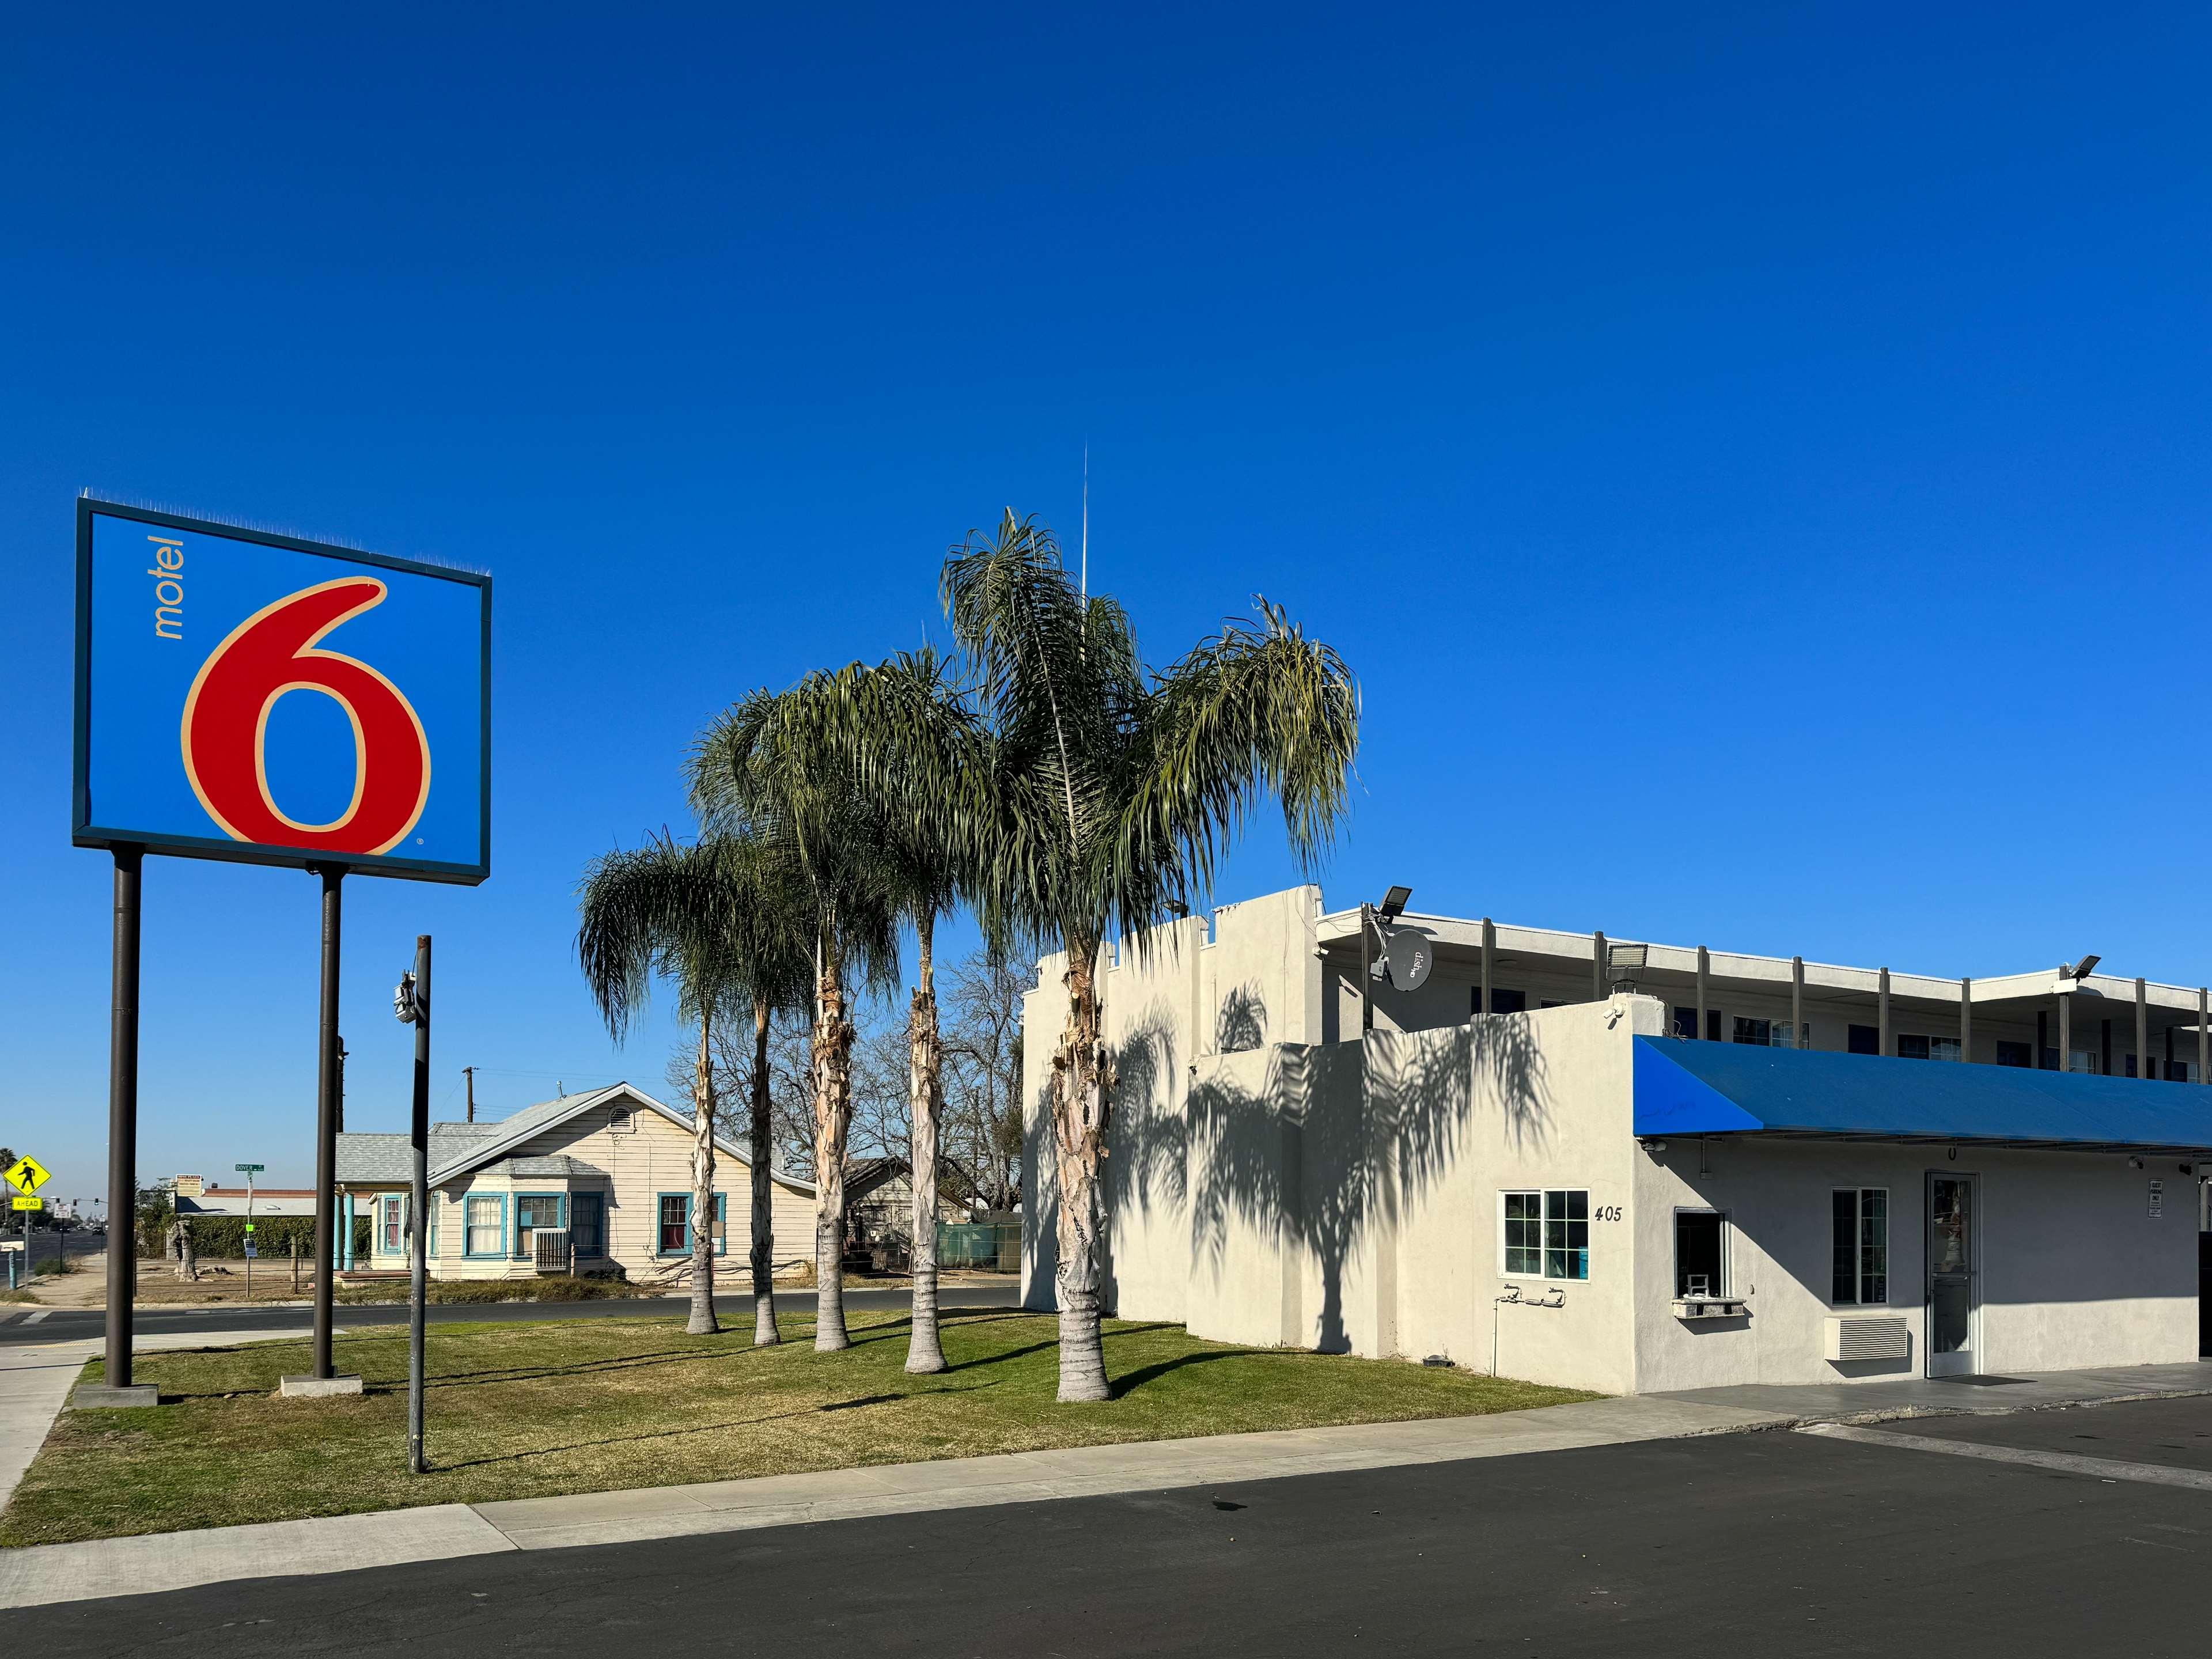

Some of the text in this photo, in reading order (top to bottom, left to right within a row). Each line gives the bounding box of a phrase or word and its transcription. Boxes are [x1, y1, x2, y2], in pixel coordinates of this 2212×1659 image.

[147, 535, 184, 640] motel
[181, 575, 431, 855] 6
[1414, 952, 1423, 971] dish
[1594, 1206, 1622, 1221] 405
